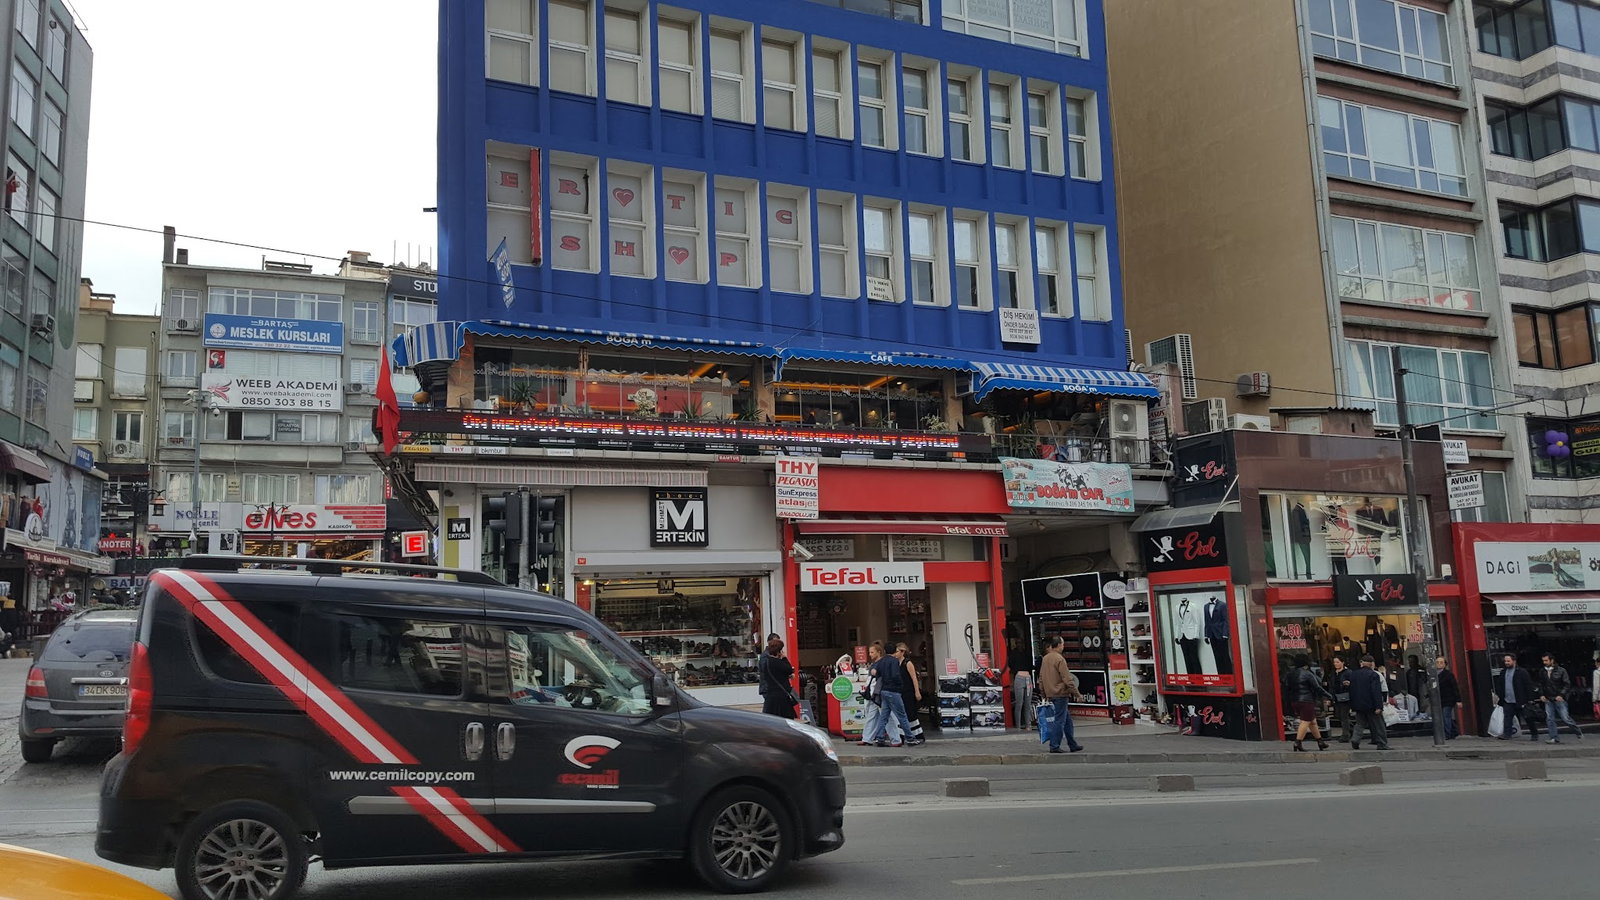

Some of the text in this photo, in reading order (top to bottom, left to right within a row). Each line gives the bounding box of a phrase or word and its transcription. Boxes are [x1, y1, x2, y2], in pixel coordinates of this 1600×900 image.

[258, 320, 292, 328] BARTAŞ
[230, 327, 330, 343] MESLEK KURSLARI
[870, 354, 892, 362] CAFE
[236, 379, 338, 390] WEEB AKADEMİ
[242, 390, 332, 398] www.weebakademi.com
[242, 397, 270, 406] 0850
[274, 398, 296, 406] 303
[300, 399, 314, 407] 88
[778, 460, 815, 474] THY
[778, 476, 816, 488] PEGASUS
[1451, 475, 1478, 485] AVUKAT
[778, 488, 816, 498] SunExpress
[778, 498, 816, 508] atlasjet
[942, 526, 970, 534] Tefal
[656, 530, 704, 542] ERTEKİN
[409, 536, 424, 552] E
[806, 568, 920, 586] Tefal OUTLET
[1064, 599, 1084, 608] PARFÜM
[96, 686, 108, 694] DK
[1120, 688, 1125, 698] 5
[330, 768, 475, 783] www.cemilcopy.com
